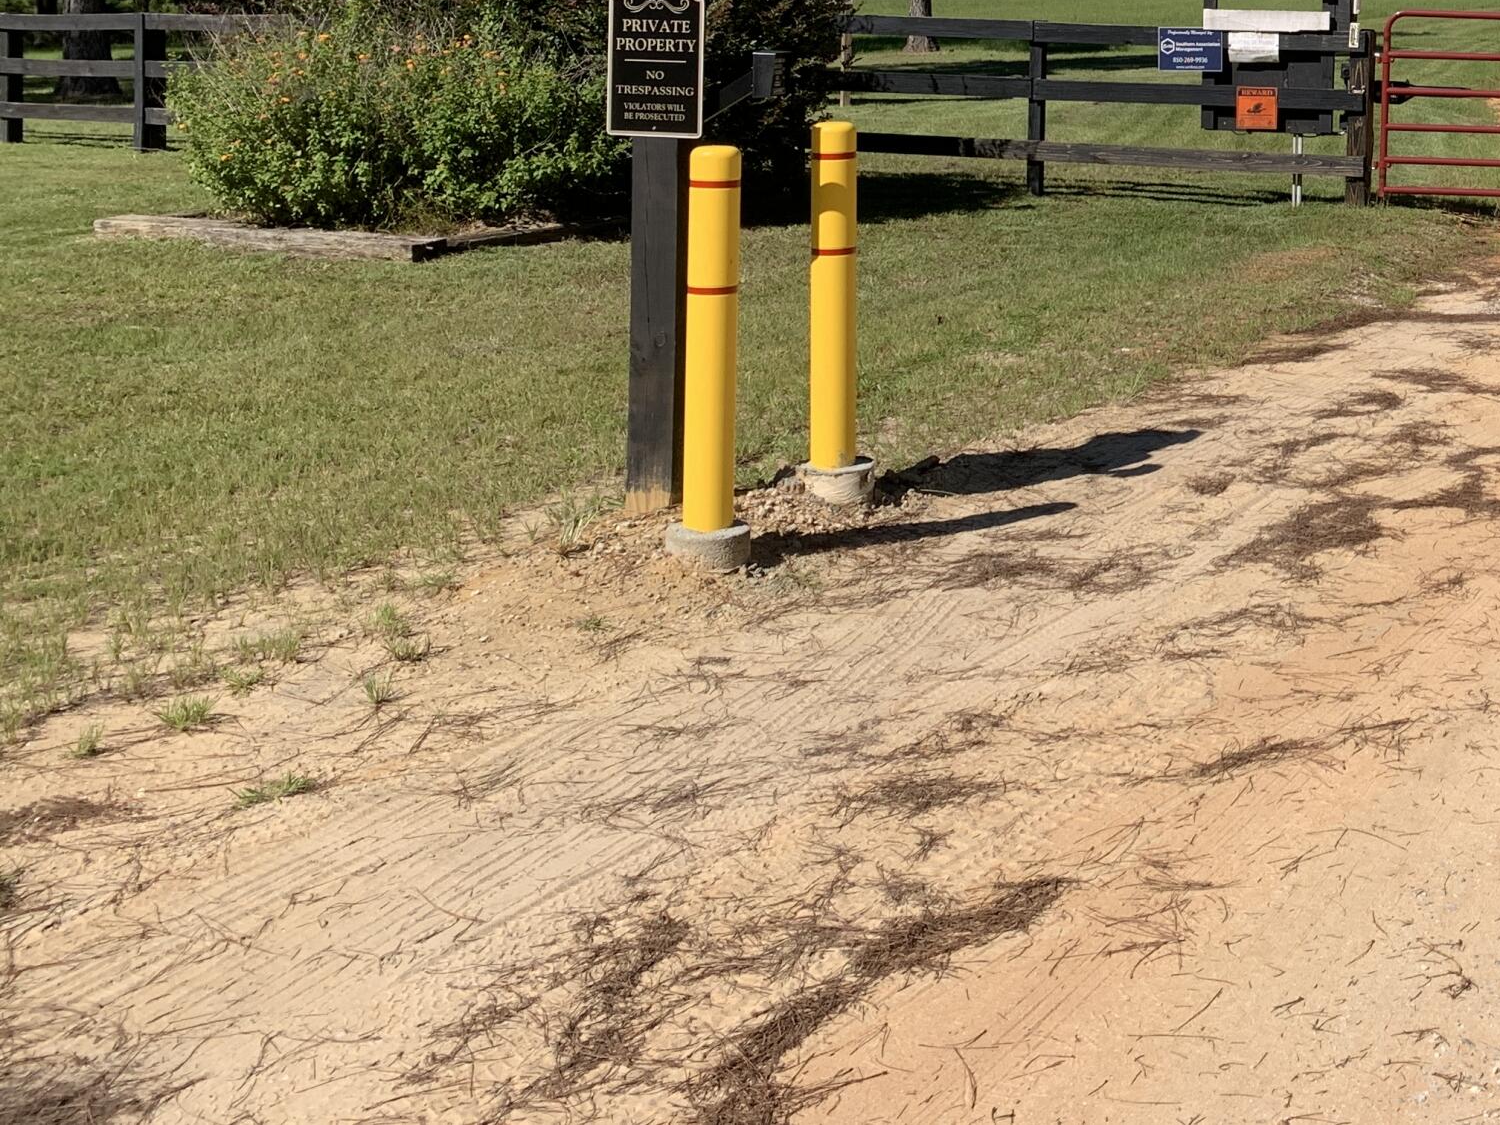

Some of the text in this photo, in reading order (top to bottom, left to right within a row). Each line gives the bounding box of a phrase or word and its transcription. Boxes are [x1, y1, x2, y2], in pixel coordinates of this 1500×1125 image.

[622, 18, 691, 33] PRIVATE
[616, 37, 696, 52] PROPERTY
[646, 70, 665, 80] NO
[616, 84, 695, 97] TRESPASSING
[624, 102, 686, 112] VIOLATORS WILL
[624, 112, 686, 122] BE PROSECUTED
